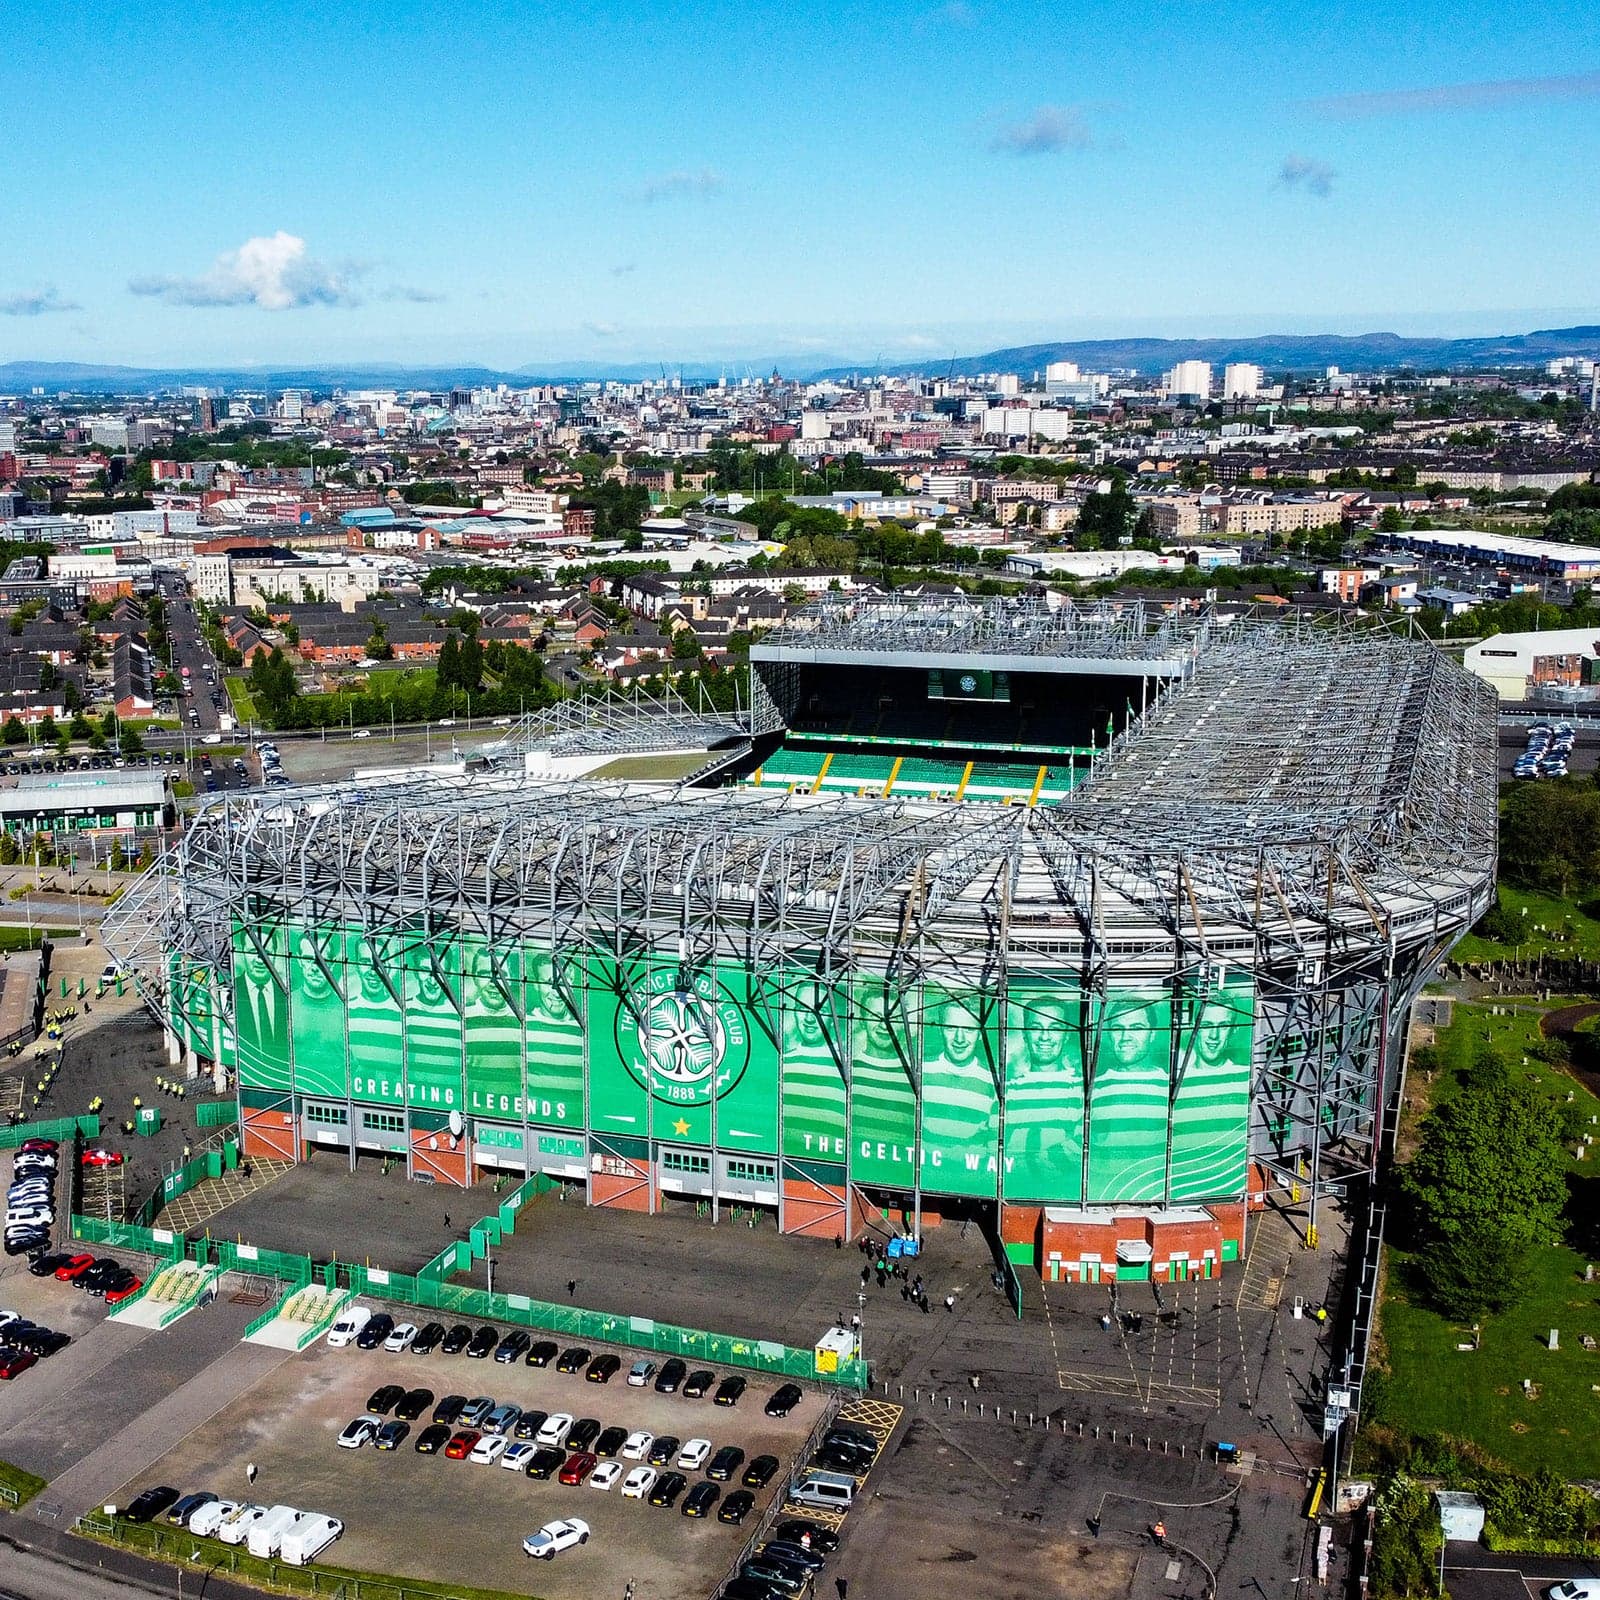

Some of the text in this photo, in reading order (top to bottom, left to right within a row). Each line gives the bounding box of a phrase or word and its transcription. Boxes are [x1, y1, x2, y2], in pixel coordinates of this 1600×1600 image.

[630, 976, 665, 1007] ELIC
[724, 1010, 743, 1045] CLUB
[354, 1077, 566, 1119] CREATING LEGENDS
[667, 1085, 696, 1100] 1888
[803, 1134, 1015, 1174] THE CELTIC WAY
